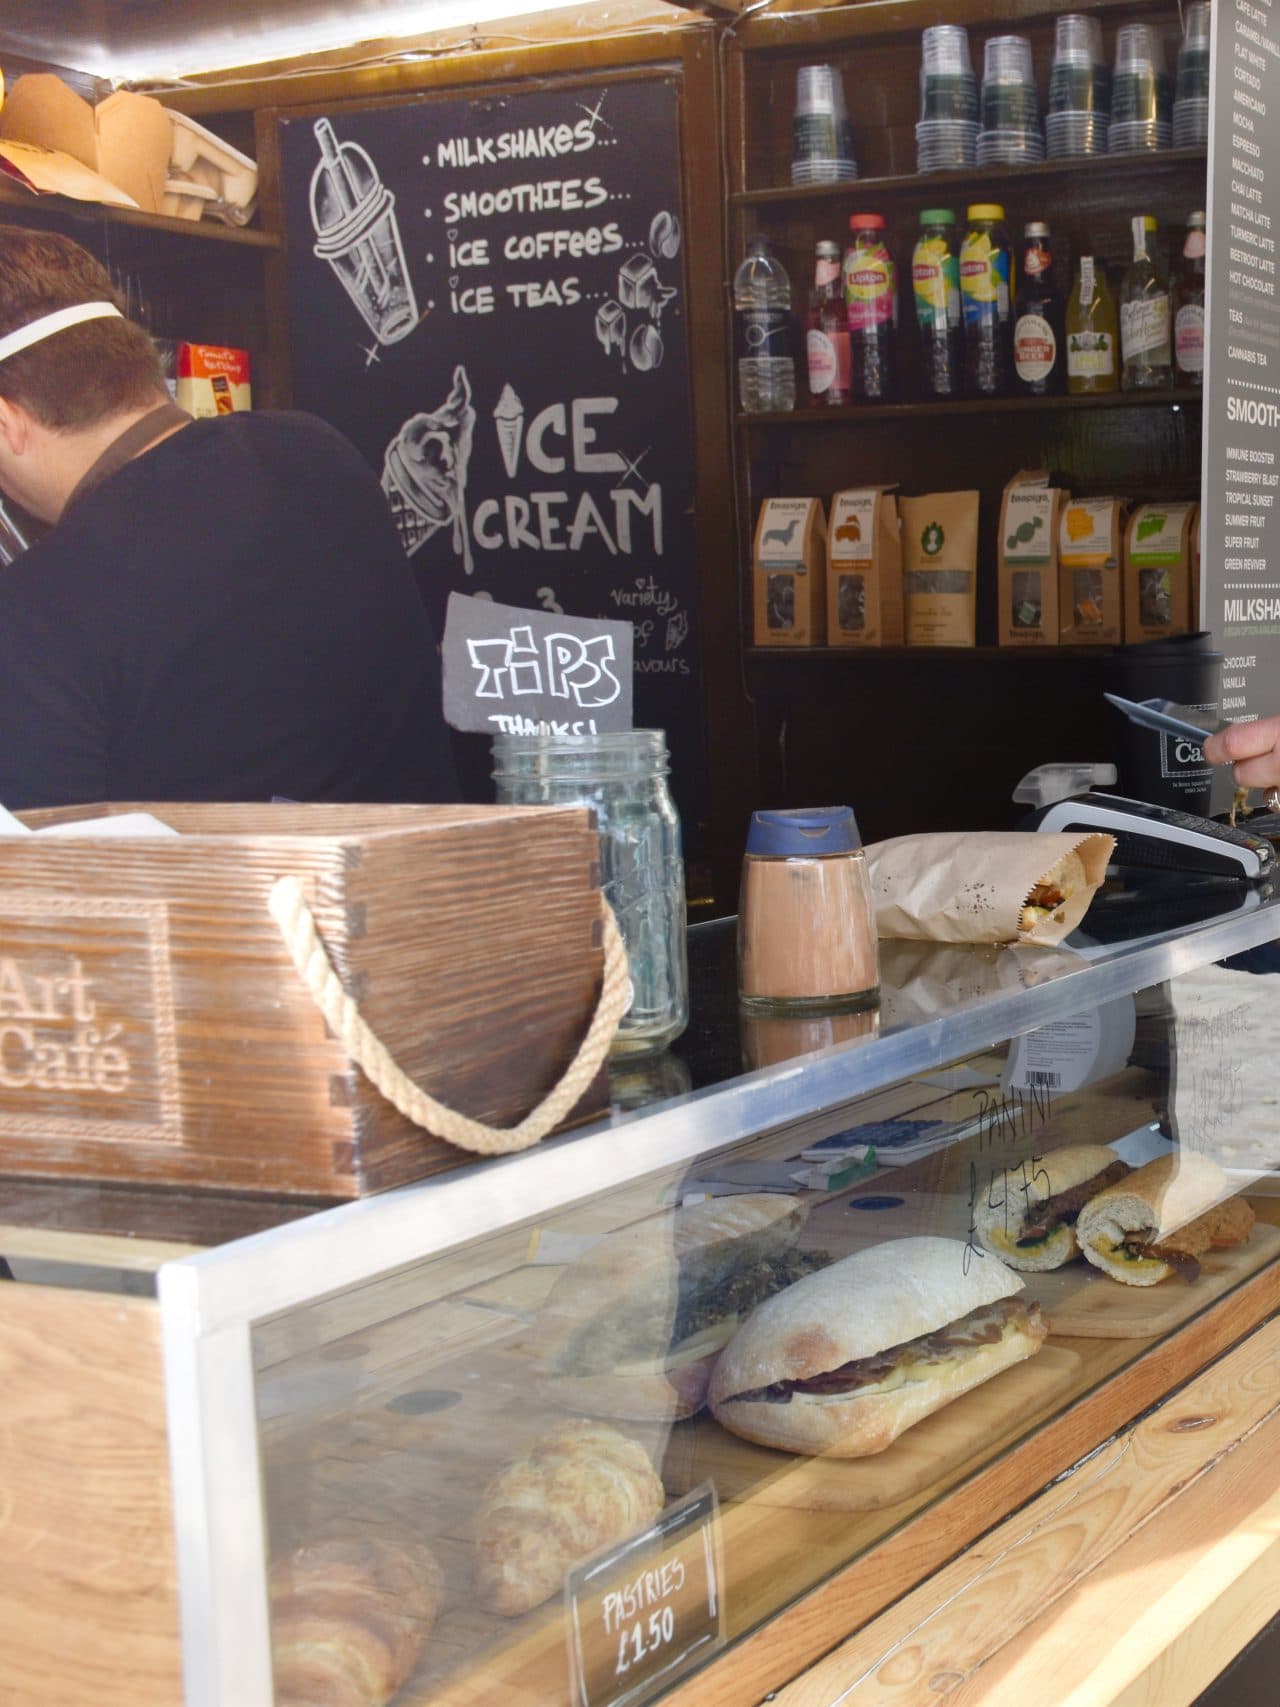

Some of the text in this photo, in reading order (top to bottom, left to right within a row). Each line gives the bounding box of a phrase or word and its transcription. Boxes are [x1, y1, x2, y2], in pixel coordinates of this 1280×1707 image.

[1251, 7, 1267, 27] LATTE
[1234, 42, 1249, 59] FLAT
[1234, 65, 1261, 91] CORTADO
[1233, 89, 1266, 116] AMERICANO
[1233, 111, 1255, 133] MOCHA
[1232, 134, 1260, 158] ESPRESSO
[1232, 157, 1264, 182] MACCHIATO
[1231, 179, 1245, 197] CHAI
[1245, 186, 1263, 204] LATTE
[1231, 202, 1254, 222] MATCHA
[1254, 211, 1272, 229] LATTE
[1230, 224, 1258, 246] TURMERIC
[1259, 236, 1275, 253] LATTE
[1230, 248, 1258, 269] BEETROOT
[1259, 258, 1275, 275] LATTE
[851, 273, 883, 286] Lipton
[1229, 270, 1242, 284] HOT
[1242, 275, 1275, 296] CHOCOLATE
[1229, 309, 1243, 324] TEAS
[1228, 345, 1256, 364] CANNABIS
[1257, 352, 1268, 367] TEA
[1226, 447, 1275, 465] IMMUNE BOOSTER
[1225, 469, 1262, 484] STRAWBERRY
[1262, 474, 1279, 487] BLAST
[1225, 491, 1252, 506] TROPICAL
[1252, 494, 1274, 507] SUNSET
[472, 483, 664, 556] CREAM
[1225, 513, 1249, 527] SUMMER
[1250, 516, 1266, 528] FRUIT
[1225, 536, 1260, 549] SUPER FRUIT
[1224, 558, 1243, 570] GREEN
[1243, 559, 1267, 570] REVIVER
[633, 657, 690, 675] avours
[1223, 655, 1256, 669] CHOCOLATE
[1223, 676, 1246, 690] VANILLA
[1222, 695, 1246, 710] BANANA
[1175, 743, 1205, 763] Ca
[0, 955, 96, 1023] Art
[0, 1022, 130, 1093] Café
[972, 1080, 1051, 1152] PANINI
[602, 1557, 685, 1635] PASTRIES
[615, 1605, 674, 1675] £1.50
